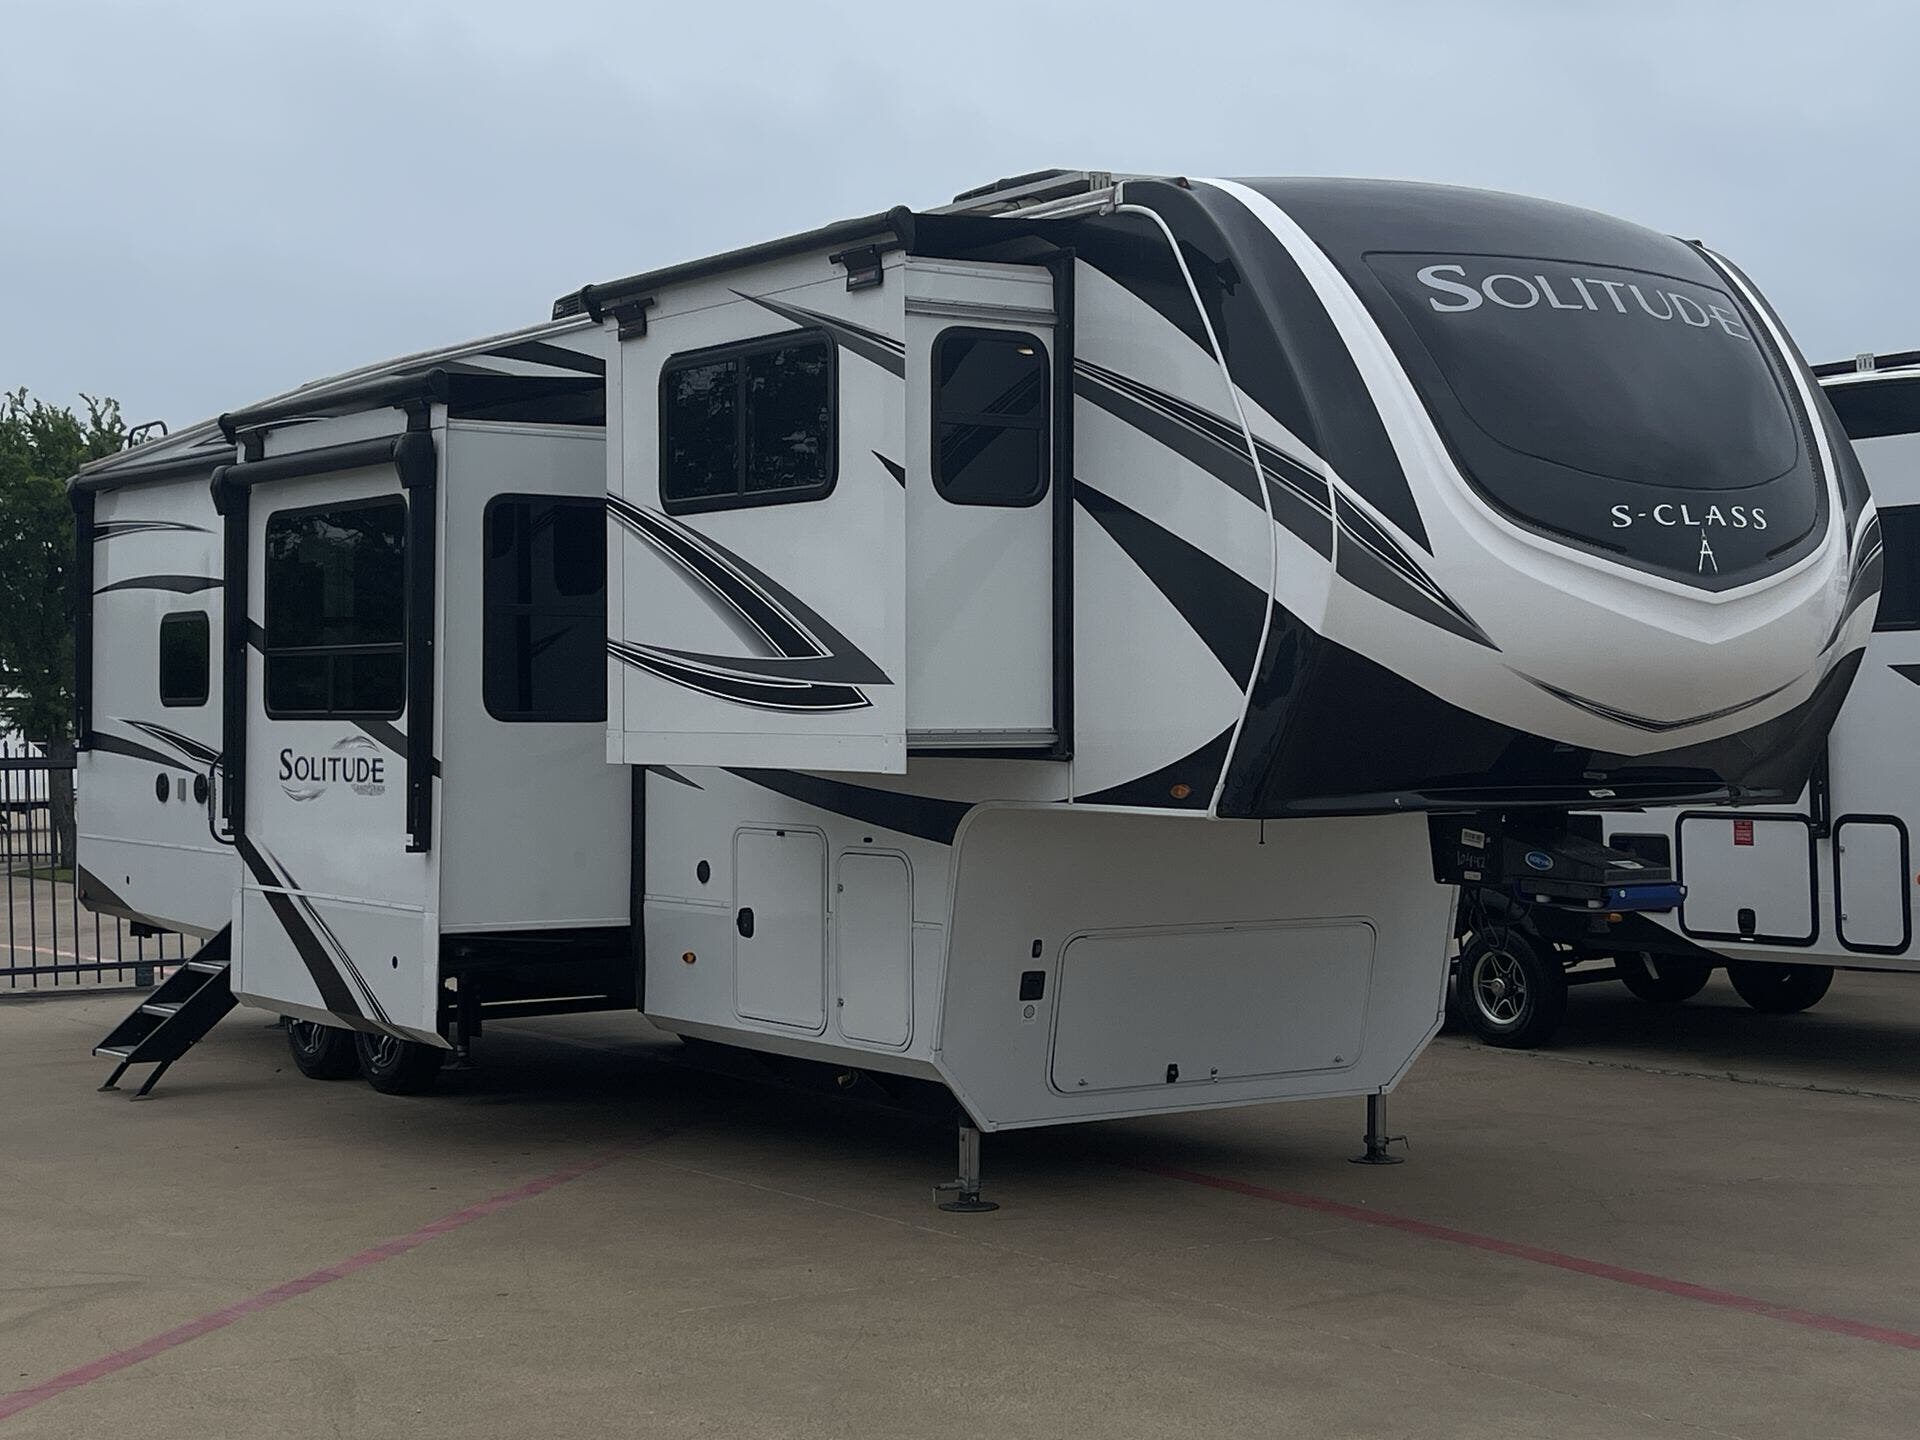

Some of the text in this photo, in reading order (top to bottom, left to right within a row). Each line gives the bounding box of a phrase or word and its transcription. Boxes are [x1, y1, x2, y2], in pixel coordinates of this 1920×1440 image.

[1417, 264, 1750, 341] SOLITUDE
[1610, 504, 1767, 530] S-CLASS
[279, 748, 384, 783] SOLITUDE
